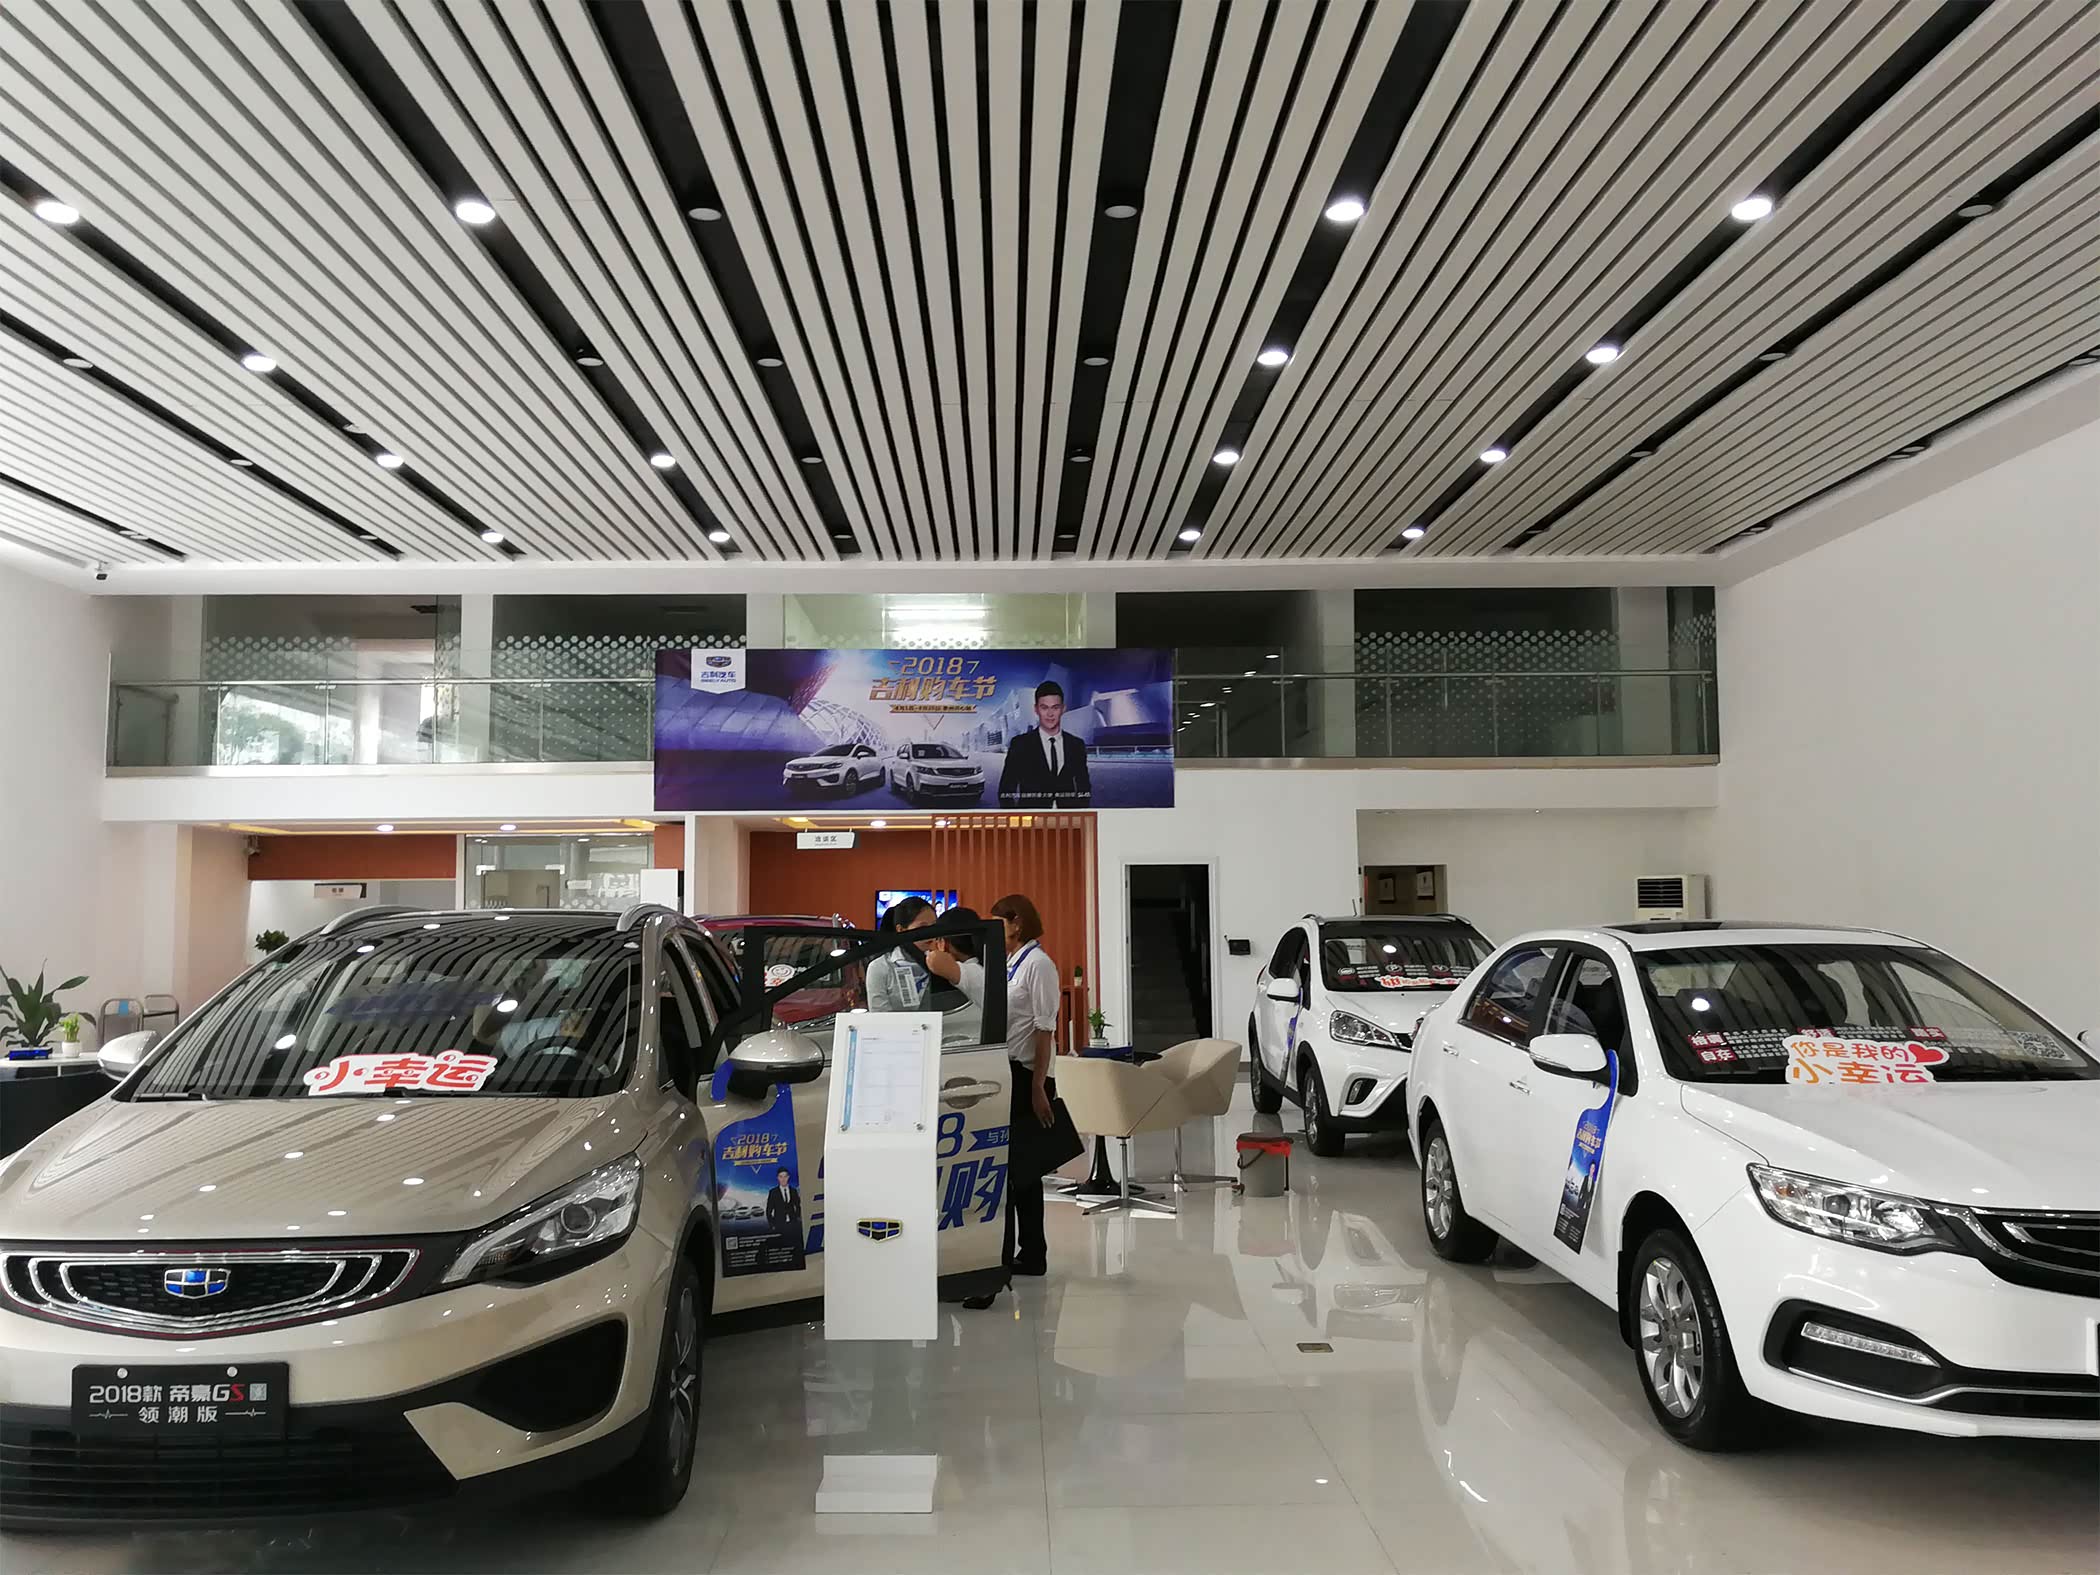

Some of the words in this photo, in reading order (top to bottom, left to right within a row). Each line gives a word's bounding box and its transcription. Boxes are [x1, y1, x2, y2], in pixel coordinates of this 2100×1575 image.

[701, 671, 736, 679] 吉利汽车
[902, 656, 964, 675] 2018
[869, 675, 997, 701] 吉利购车节
[1701, 1049, 1734, 1061] 自在
[1791, 1041, 1909, 1062] 你是我的
[314, 1054, 489, 1091] 小幸运
[1792, 1058, 1929, 1083] 小幸运
[737, 1132, 770, 1145] 2018
[722, 1142, 788, 1160] 吉利购车节
[937, 1156, 1009, 1232] 购
[89, 1385, 162, 1404] 2018款
[169, 1383, 246, 1402] 帝豪GS
[138, 1406, 218, 1424] 领潮版
